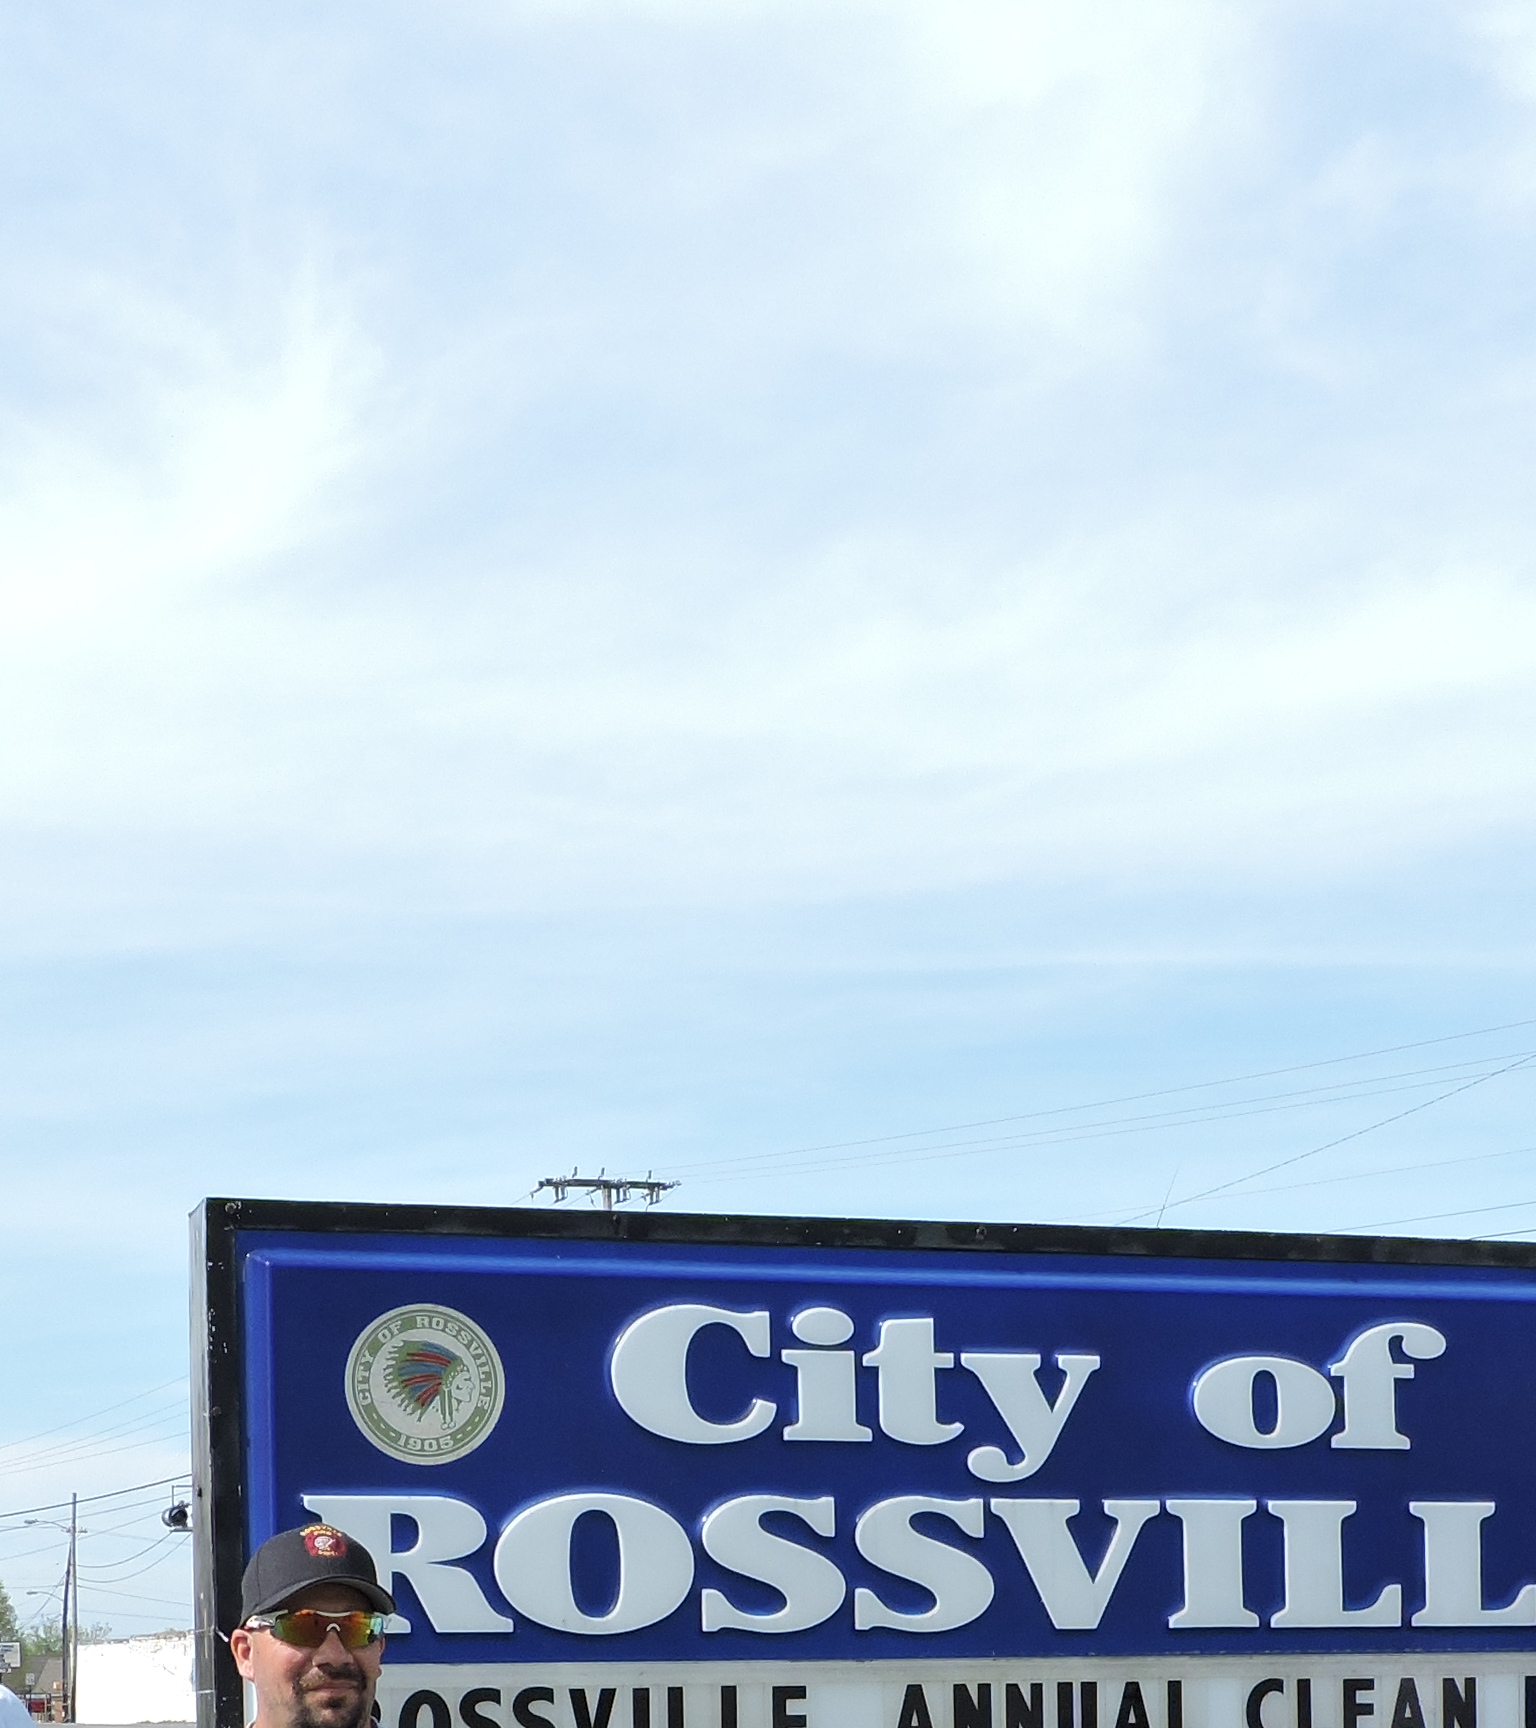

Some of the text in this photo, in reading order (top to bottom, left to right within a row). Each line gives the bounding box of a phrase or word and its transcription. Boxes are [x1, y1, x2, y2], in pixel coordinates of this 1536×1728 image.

[357, 1314, 494, 1411] CITY OF ROSSVILLE
[610, 1303, 1447, 1484] City of
[396, 1434, 455, 1451] 1905
